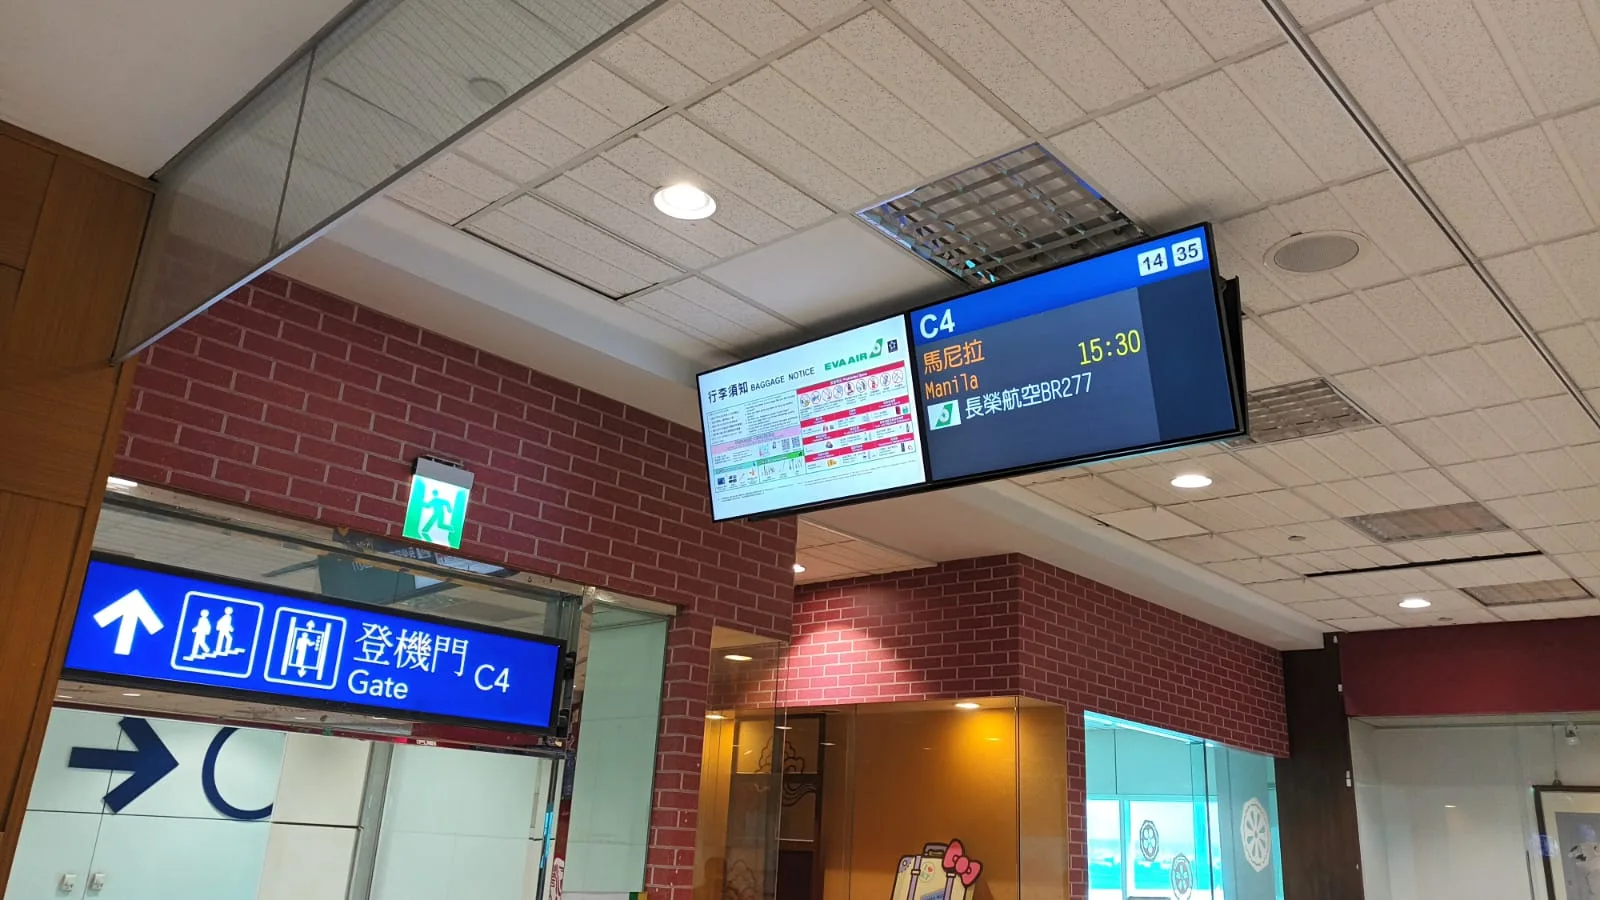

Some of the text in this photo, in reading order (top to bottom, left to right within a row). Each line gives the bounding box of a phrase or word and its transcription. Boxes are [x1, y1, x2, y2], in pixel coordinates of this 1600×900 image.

[1142, 242, 1199, 271] 14 35
[919, 308, 956, 339] C4
[824, 352, 868, 371] EVA AIR
[923, 339, 985, 375] 馬尼拉
[1078, 329, 1142, 366] 15:30
[707, 381, 750, 404] 行李須知
[750, 375, 785, 392] BAGGAGE
[788, 366, 816, 381] NOTICE
[925, 373, 980, 400] Manila
[965, 372, 1093, 420] 長榮航空BR277
[353, 622, 469, 677] 登機門
[347, 669, 409, 700] Gate
[474, 663, 510, 693] C4
